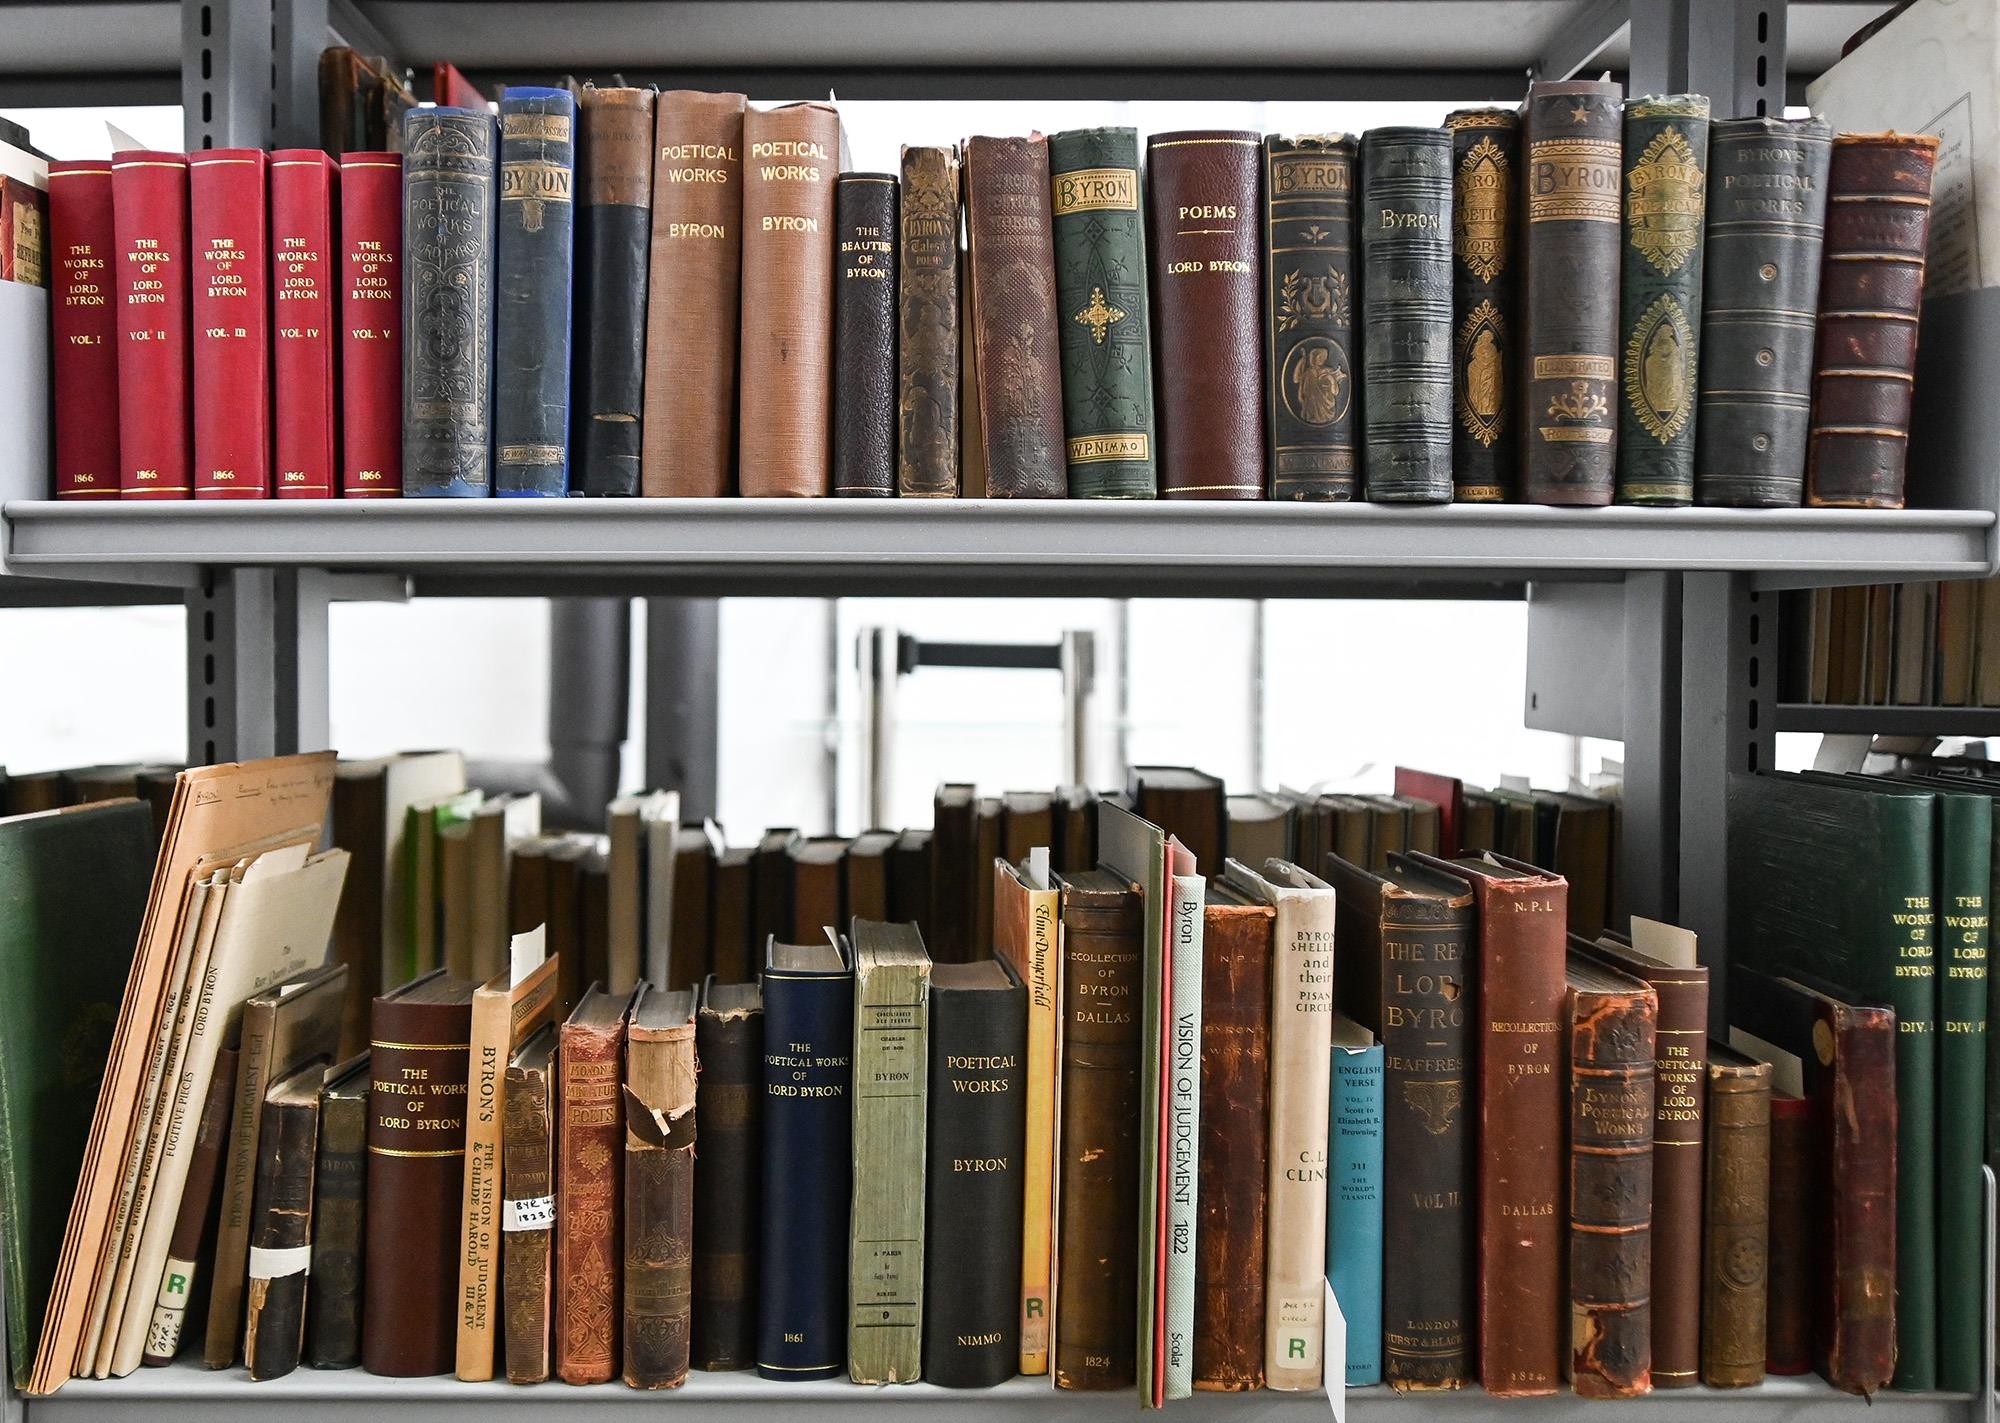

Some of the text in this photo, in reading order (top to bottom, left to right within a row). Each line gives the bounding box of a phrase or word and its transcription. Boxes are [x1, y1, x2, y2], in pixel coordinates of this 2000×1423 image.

[662, 144, 738, 162] POETICAL
[752, 141, 828, 160] POETICAL
[669, 168, 728, 184] WORKS
[761, 165, 820, 182] WORKS
[1536, 162, 1618, 196] BYRON
[503, 169, 569, 194] BYRON
[1724, 174, 1815, 192] POETICAL
[1060, 177, 1128, 208] BYRON
[1735, 199, 1804, 214] WORKS
[1179, 206, 1237, 220] POEMS
[762, 216, 818, 232] BYRON
[1381, 209, 1440, 229] BYRON
[669, 223, 725, 239] BYRON
[855, 226, 879, 236] THE
[135, 239, 158, 249] THE
[212, 239, 234, 249] THE
[284, 238, 306, 248] THE
[358, 241, 381, 250] THE
[841, 241, 891, 252] BEAUTIES
[70, 246, 91, 255] THE
[205, 250, 245, 260] WORKS
[128, 252, 170, 262] WORKS
[278, 252, 318, 261] WORKS
[352, 253, 393, 262] WORKS
[858, 255, 874, 264] OF
[64, 259, 104, 268] WORKS
[142, 264, 157, 273] OF
[217, 262, 232, 271] OF
[289, 263, 304, 273] OF
[363, 263, 378, 273] OF
[1168, 261, 1250, 274] LORD BYRON
[74, 271, 89, 280] OF
[846, 268, 886, 278] BYRON
[133, 280, 162, 290] LORD
[212, 275, 242, 285] LORD
[285, 278, 314, 287] LORD
[356, 278, 387, 287] LORD
[70, 284, 98, 294] LORD
[208, 287, 247, 297] BYRON
[280, 290, 318, 299] BYRON
[352, 289, 391, 300] BYRON
[66, 296, 104, 305] BYRON
[128, 294, 165, 304] BYRON
[157, 331, 165, 340] II
[206, 329, 247, 338] VOL. III
[307, 329, 318, 338] IV
[352, 329, 391, 339] VOL. V
[96, 335, 101, 344] I
[1539, 360, 1609, 373] ILLUSTRATED
[74, 473, 94, 483] 1866
[136, 469, 157, 480] 1866
[212, 469, 235, 480] 1866
[284, 471, 305, 481] 1866
[359, 470, 382, 481] 1866
[1515, 901, 1543, 913] N. P.
[1905, 896, 1930, 909] THE
[1955, 896, 1983, 908] THE
[1181, 901, 1198, 944] Byron
[1910, 929, 1926, 941] OF
[1962, 931, 1979, 943] OF
[1386, 942, 1425, 961] THE
[1900, 946, 1933, 957] LORD
[1954, 947, 1986, 959] LORD
[1303, 956, 1329, 969] and
[1029, 937, 1051, 1011] Dangerfield
[1098, 969, 1115, 978] OF
[1299, 970, 1331, 983] their
[1079, 984, 1129, 996] BYRON
[1076, 1011, 1131, 1024] DALLAS
[1900, 1022, 1927, 1033] DIV.
[1945, 1021, 1974, 1034] DIV.
[789, 1042, 811, 1053] THE
[1524, 1043, 1538, 1053] OF
[1667, 1046, 1690, 1057] THE
[166, 966, 218, 1157] FUGITIVE PIECES LORD BYRON
[764, 1054, 813, 1067] POETICAL
[947, 1055, 1017, 1068] POETICAL
[402, 1068, 428, 1080] THE
[570, 1062, 617, 1077] MOXON'S
[1338, 1066, 1381, 1075] ENGLISH
[1508, 1063, 1551, 1075] BYRON
[792, 1071, 807, 1081] OF
[875, 1072, 910, 1081] BYRON
[1660, 1073, 1697, 1083] WORKS
[373, 1080, 425, 1095] POETICAL
[479, 1046, 497, 1122] BYRON'S
[952, 1079, 1009, 1093] WORKS
[1345, 1079, 1376, 1087] VERSE
[768, 1084, 843, 1097] LORD BYRON
[1671, 1085, 1687, 1095] OF
[407, 1101, 425, 1113] OF
[1663, 1096, 1696, 1107] LORD
[116, 991, 177, 1233] BYRON'S C. ROE.
[572, 1107, 614, 1123] POETS
[1344, 1106, 1364, 1114] Scott
[1581, 1103, 1649, 1120] POETICAL
[1658, 1110, 1700, 1121] BYRON
[124, 985, 193, 1259] LORD BYRON'S FUGITIVE PIECES HERBERT C. ROE.
[379, 1116, 460, 1130] LORD BYRON
[1338, 1117, 1371, 1125] Elizabeth
[1341, 1128, 1378, 1137] Browning
[1594, 1120, 1643, 1135] WORKS
[1173, 1013, 1194, 1254] VISION OF JUDGEMENT 1822
[1300, 1151, 1314, 1163] C.
[953, 1157, 1007, 1172] BYRON
[1503, 1203, 1553, 1216] DALLAS
[518, 1211, 546, 1222] 1823
[463, 1142, 483, 1330] & CHILDE HAROLD III & IV
[475, 1143, 494, 1330] THE VISION OF JUDGMENT
[167, 1273, 187, 1294] R
[1026, 1297, 1043, 1319] R
[1407, 1319, 1459, 1331] LONDON
[784, 1333, 804, 1343] 1861
[957, 1332, 1002, 1346] NIMMO
[1171, 1333, 1183, 1368] Scolar
[1288, 1338, 1307, 1359] R
[1085, 1356, 1111, 1367] 1824
